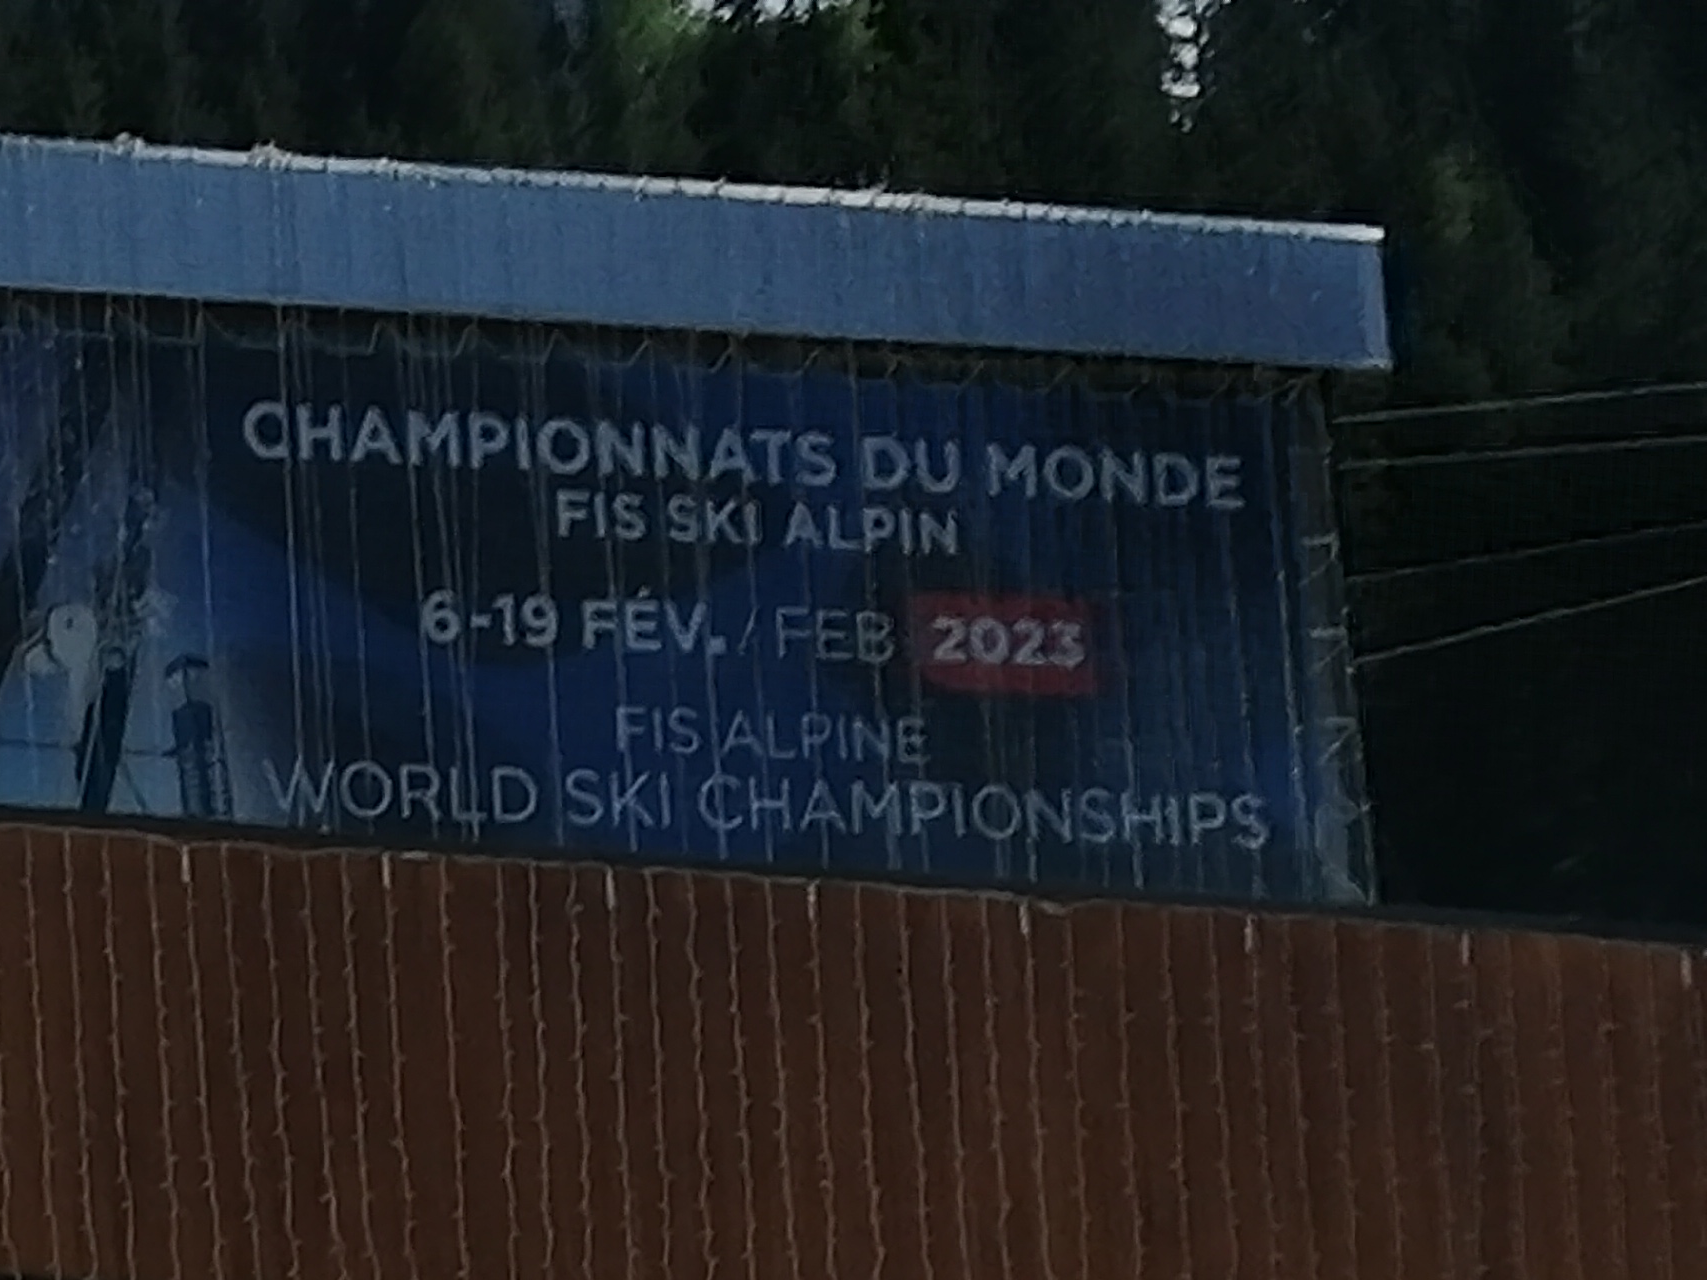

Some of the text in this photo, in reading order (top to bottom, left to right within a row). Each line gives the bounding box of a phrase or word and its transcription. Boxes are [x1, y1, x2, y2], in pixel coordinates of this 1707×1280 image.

[241, 398, 1246, 510] CHAMPIONNATS DU MONDE
[554, 487, 960, 556] FIS SKI ALPIN
[421, 590, 559, 647] 6-19
[581, 586, 727, 652] FÉV.
[931, 615, 1086, 669] 2023
[616, 705, 930, 765] FIS ALPINE
[262, 759, 1269, 850] WORLD SKI CHAMPIONSHIPS
